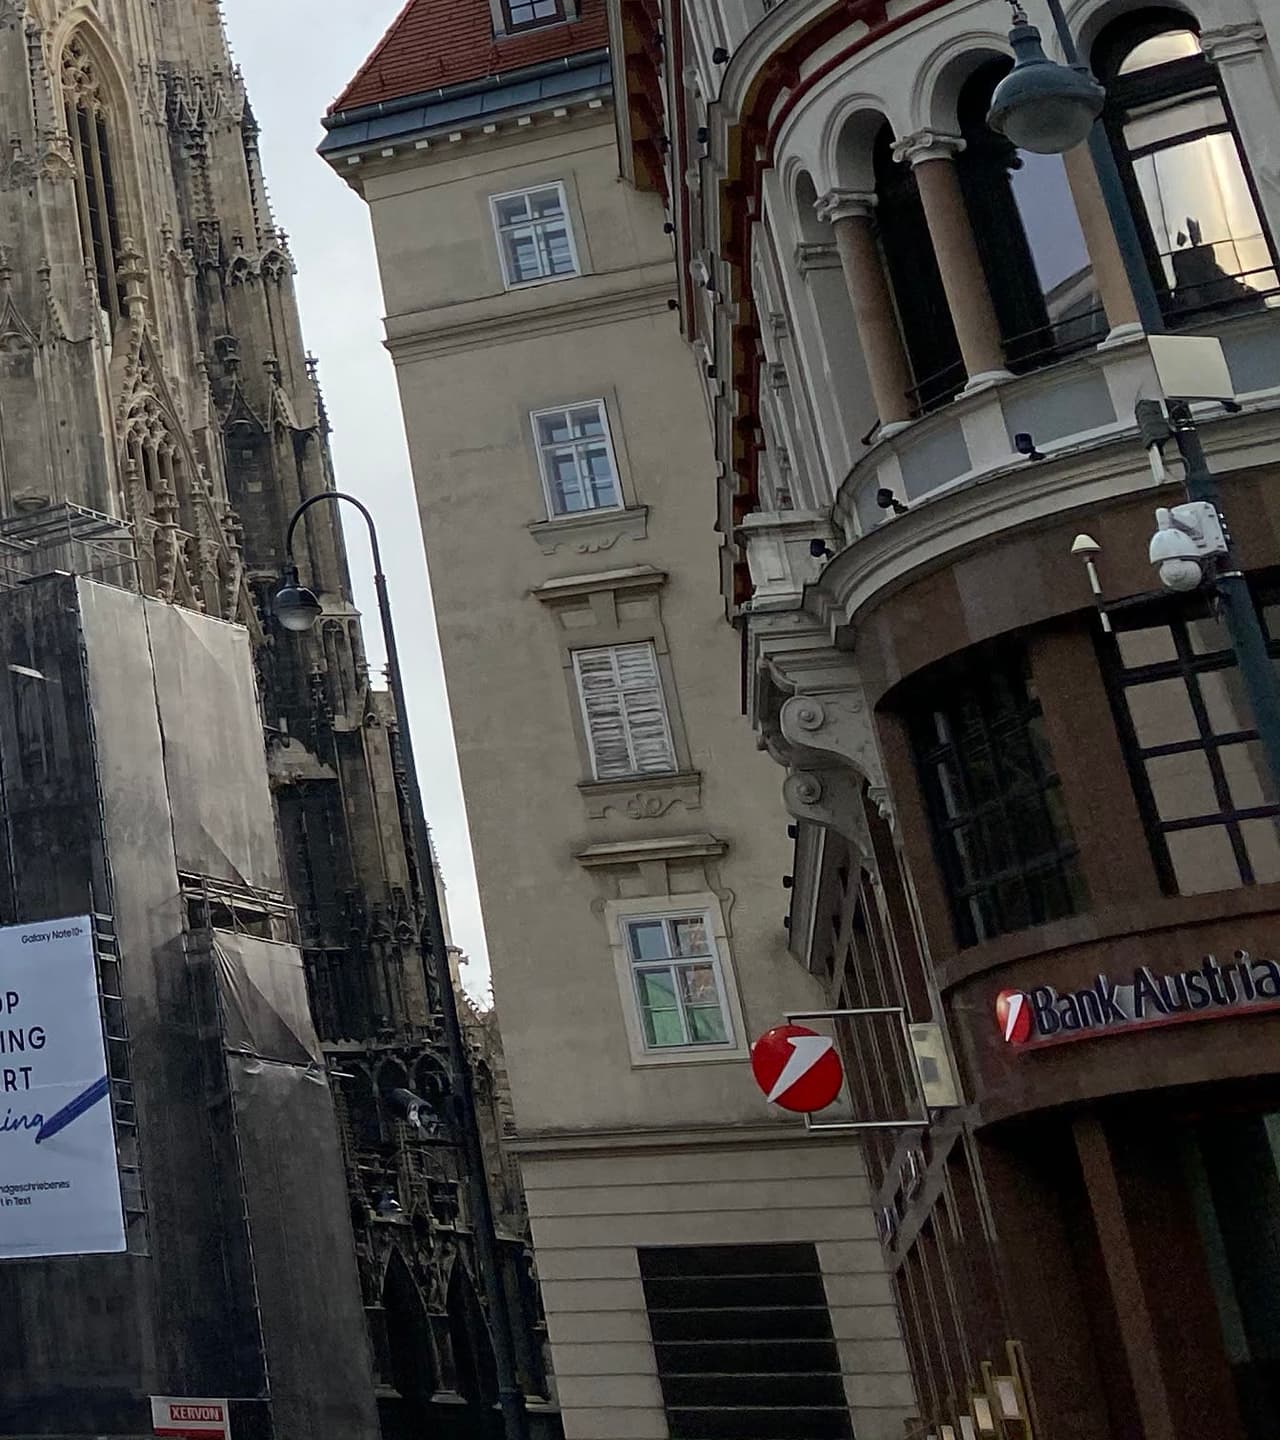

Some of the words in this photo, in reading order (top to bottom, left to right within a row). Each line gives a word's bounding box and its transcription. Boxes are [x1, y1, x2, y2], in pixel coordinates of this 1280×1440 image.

[21, 932, 51, 945] Galaxy
[52, 928, 83, 941] Note10+
[1030, 974, 1129, 1036] Bank
[1134, 949, 1280, 1019] Austria
[5, 1197, 14, 1207] in
[14, 1196, 32, 1207] Text
[171, 1406, 220, 1420] XERVON
